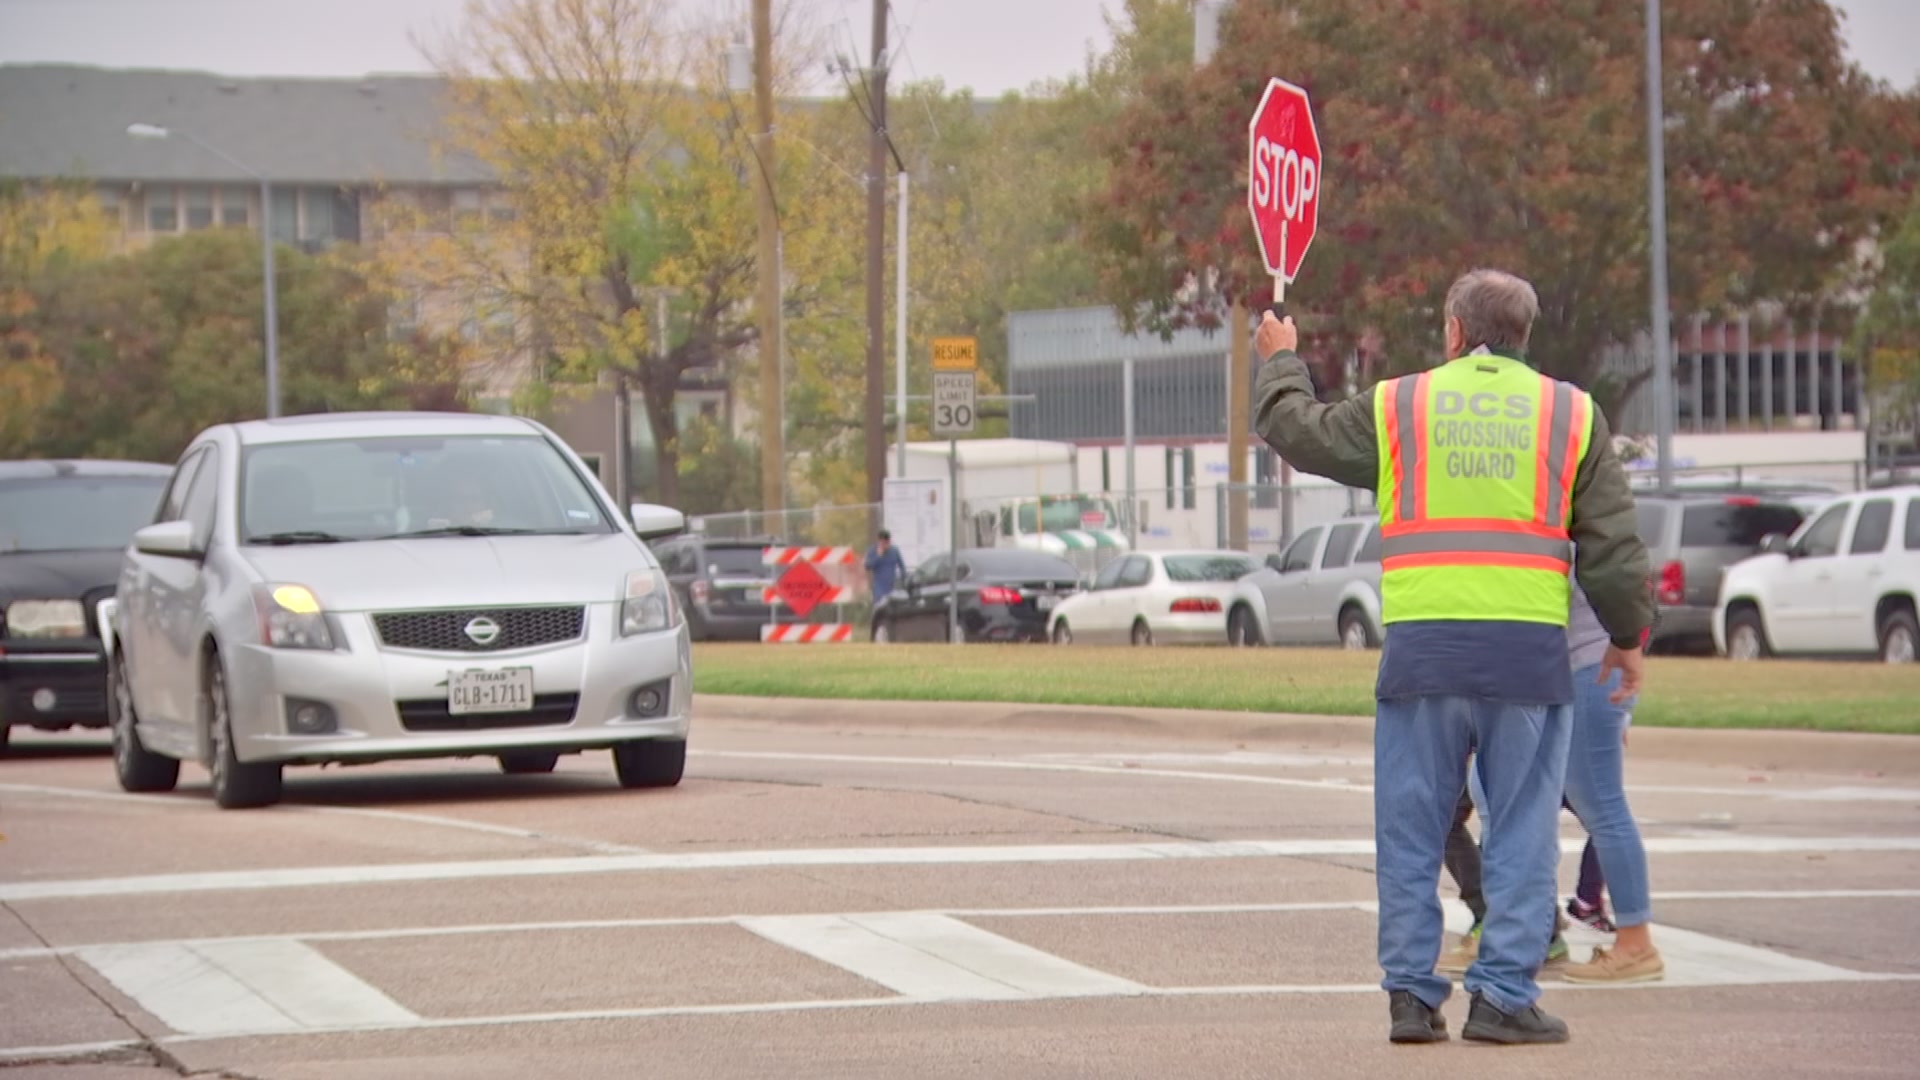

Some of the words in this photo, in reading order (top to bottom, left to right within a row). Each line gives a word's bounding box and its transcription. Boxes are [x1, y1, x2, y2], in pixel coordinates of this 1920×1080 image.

[1255, 136, 1316, 223] STOP
[935, 344, 974, 360] RESUME
[936, 378, 973, 389] SPEED
[939, 391, 968, 401] LIMIT
[1435, 390, 1532, 419] DCS
[937, 404, 972, 427] 30
[1433, 420, 1532, 452] CROSSING
[1447, 450, 1516, 481] GUARD
[475, 672, 507, 682] TEXAS
